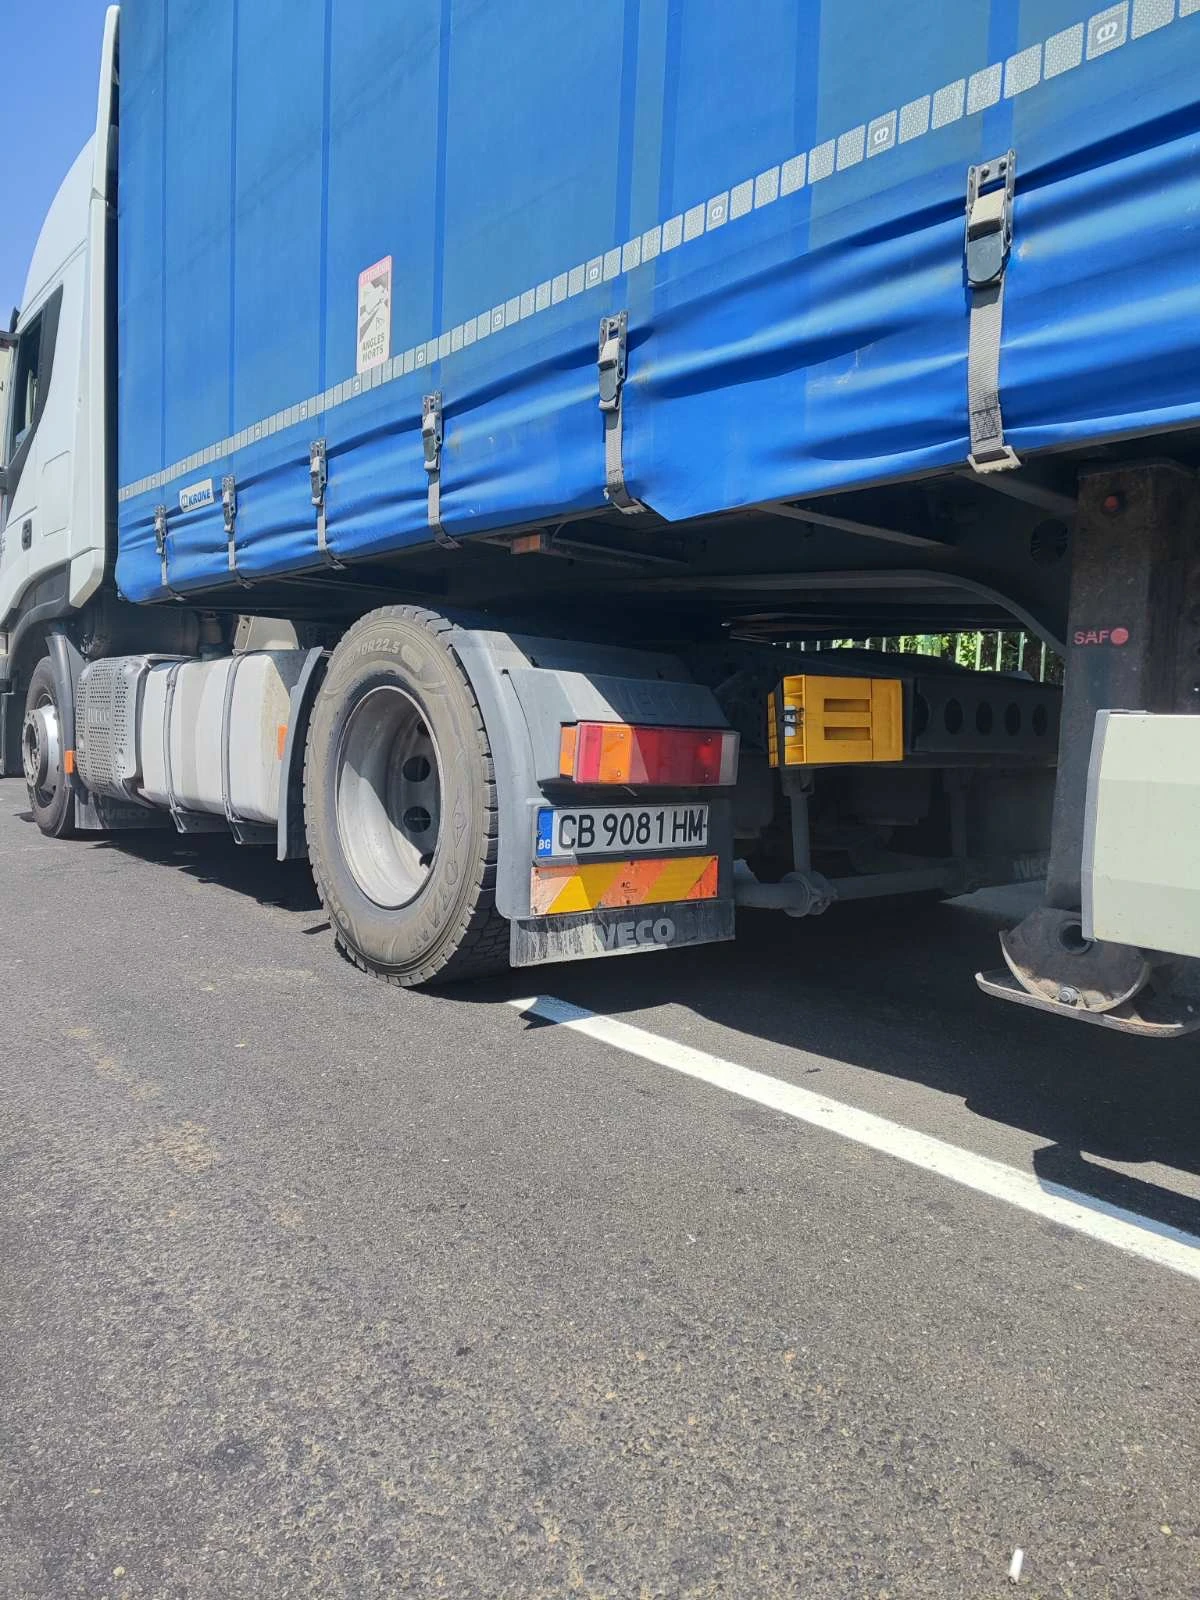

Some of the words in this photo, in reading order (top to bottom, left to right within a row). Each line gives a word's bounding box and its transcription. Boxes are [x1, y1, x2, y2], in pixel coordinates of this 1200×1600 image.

[361, 332, 384, 352] ANGLES
[189, 488, 211, 506] KRONE
[1074, 629, 1110, 645] SAF
[558, 813, 596, 849] CB
[602, 811, 665, 847] 9081
[671, 808, 704, 843] HM
[537, 838, 552, 850] BG
